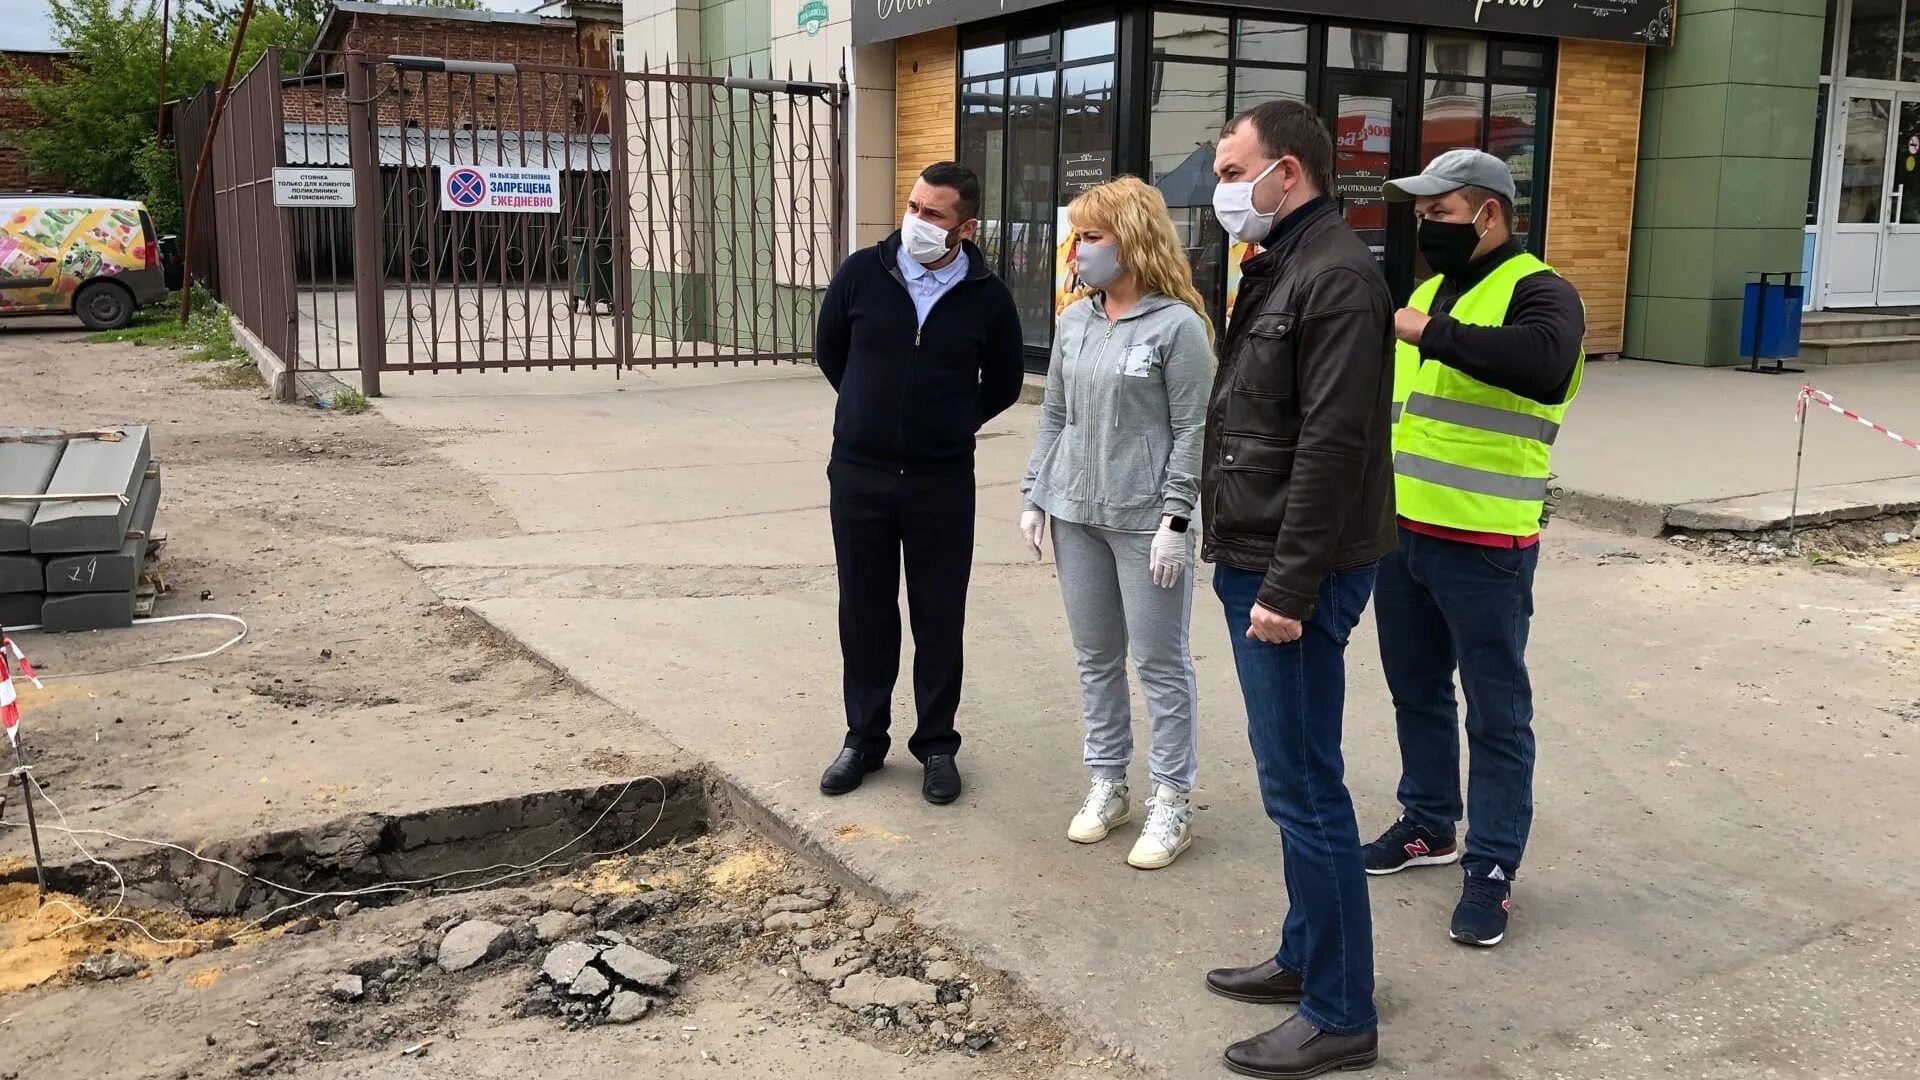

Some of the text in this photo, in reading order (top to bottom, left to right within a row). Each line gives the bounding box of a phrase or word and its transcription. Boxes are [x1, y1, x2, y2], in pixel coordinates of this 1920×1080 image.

[490, 181, 552, 194] ЗАПРЕЩЕНА
[490, 195, 553, 208] ЕЖЕДНЕВНО
[1404, 838, 1431, 858] N
